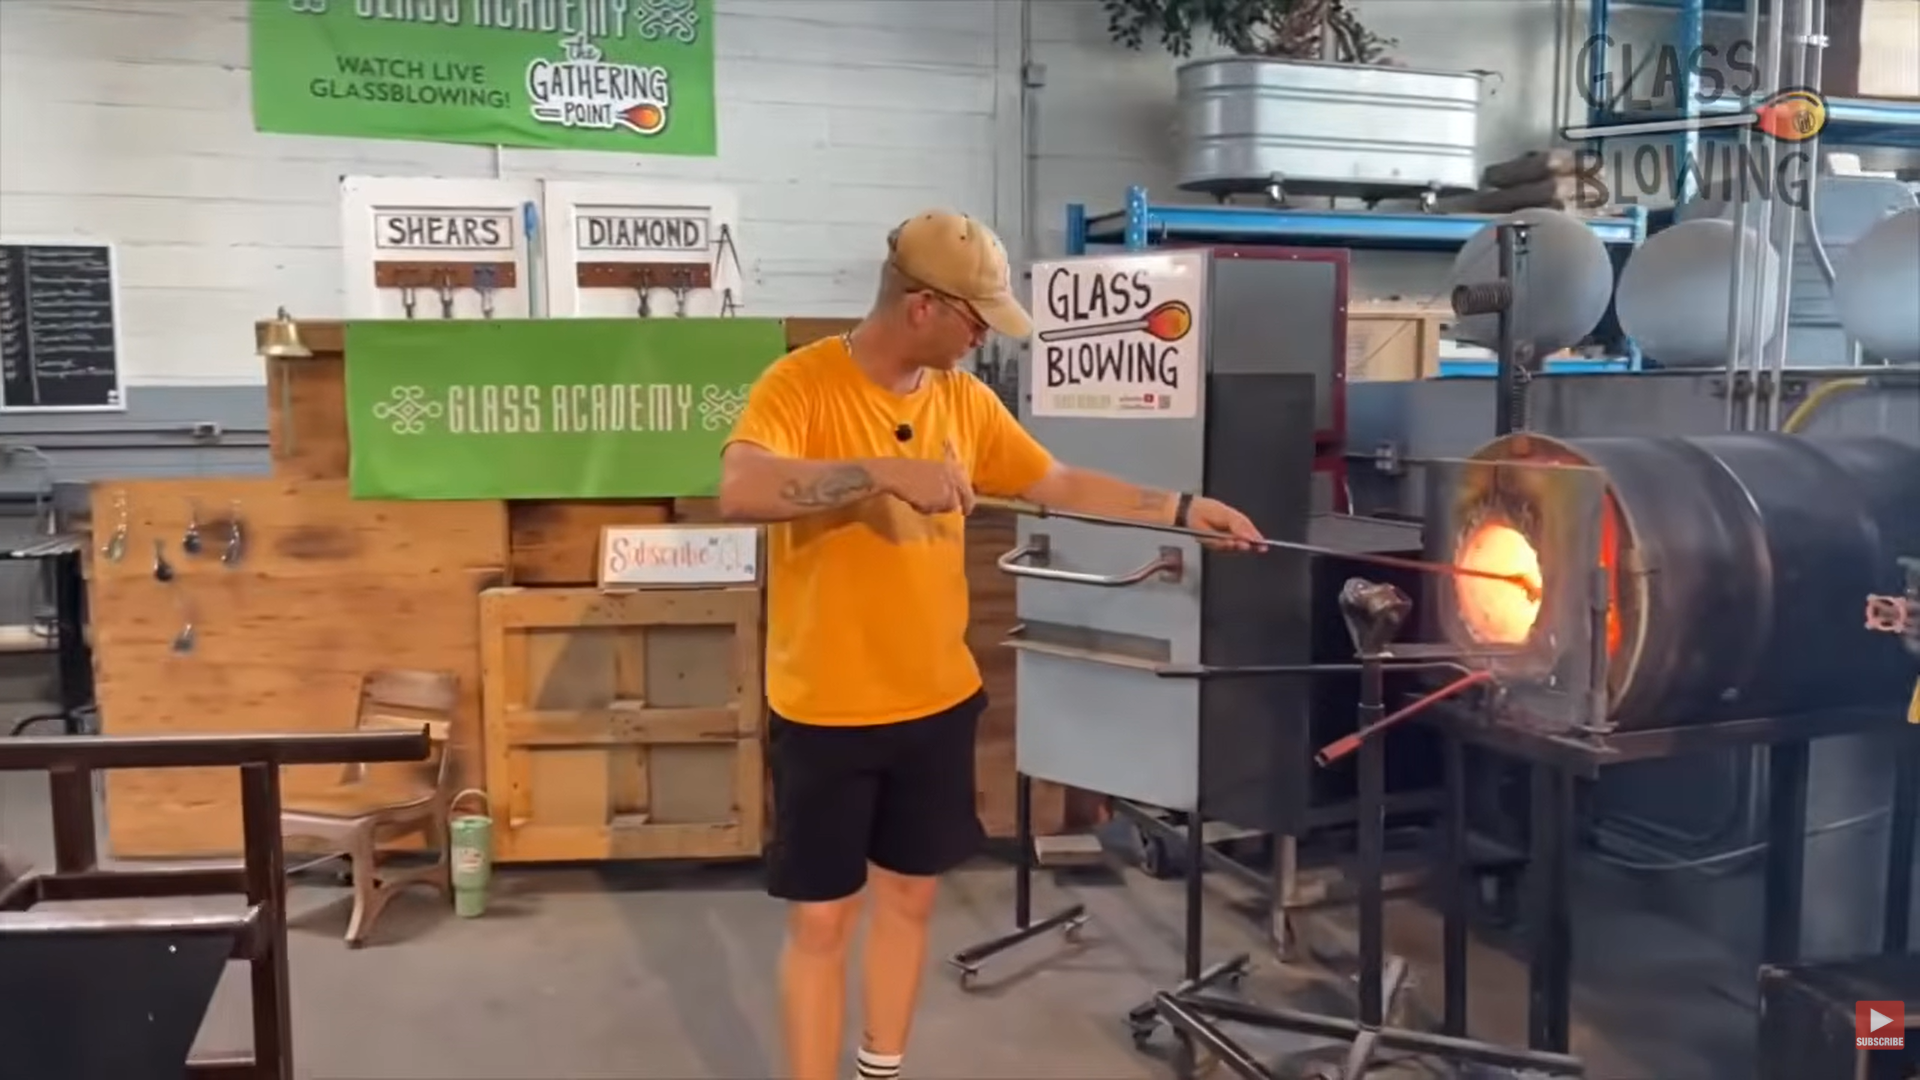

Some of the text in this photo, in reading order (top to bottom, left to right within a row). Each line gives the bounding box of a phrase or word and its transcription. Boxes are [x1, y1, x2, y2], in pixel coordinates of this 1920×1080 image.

[564, 36, 599, 59] the
[336, 55, 486, 84] WATCH LIVE
[530, 61, 665, 102] GATHERING
[309, 78, 511, 109] GLASSBLOWING!
[564, 102, 612, 124] POINT
[388, 217, 500, 246] SHEARS
[588, 218, 700, 246] DIAMOND
[1048, 267, 1151, 323] GLASS
[1047, 339, 1179, 389] BLOWING
[448, 384, 693, 434] GLASS ACADEMY
